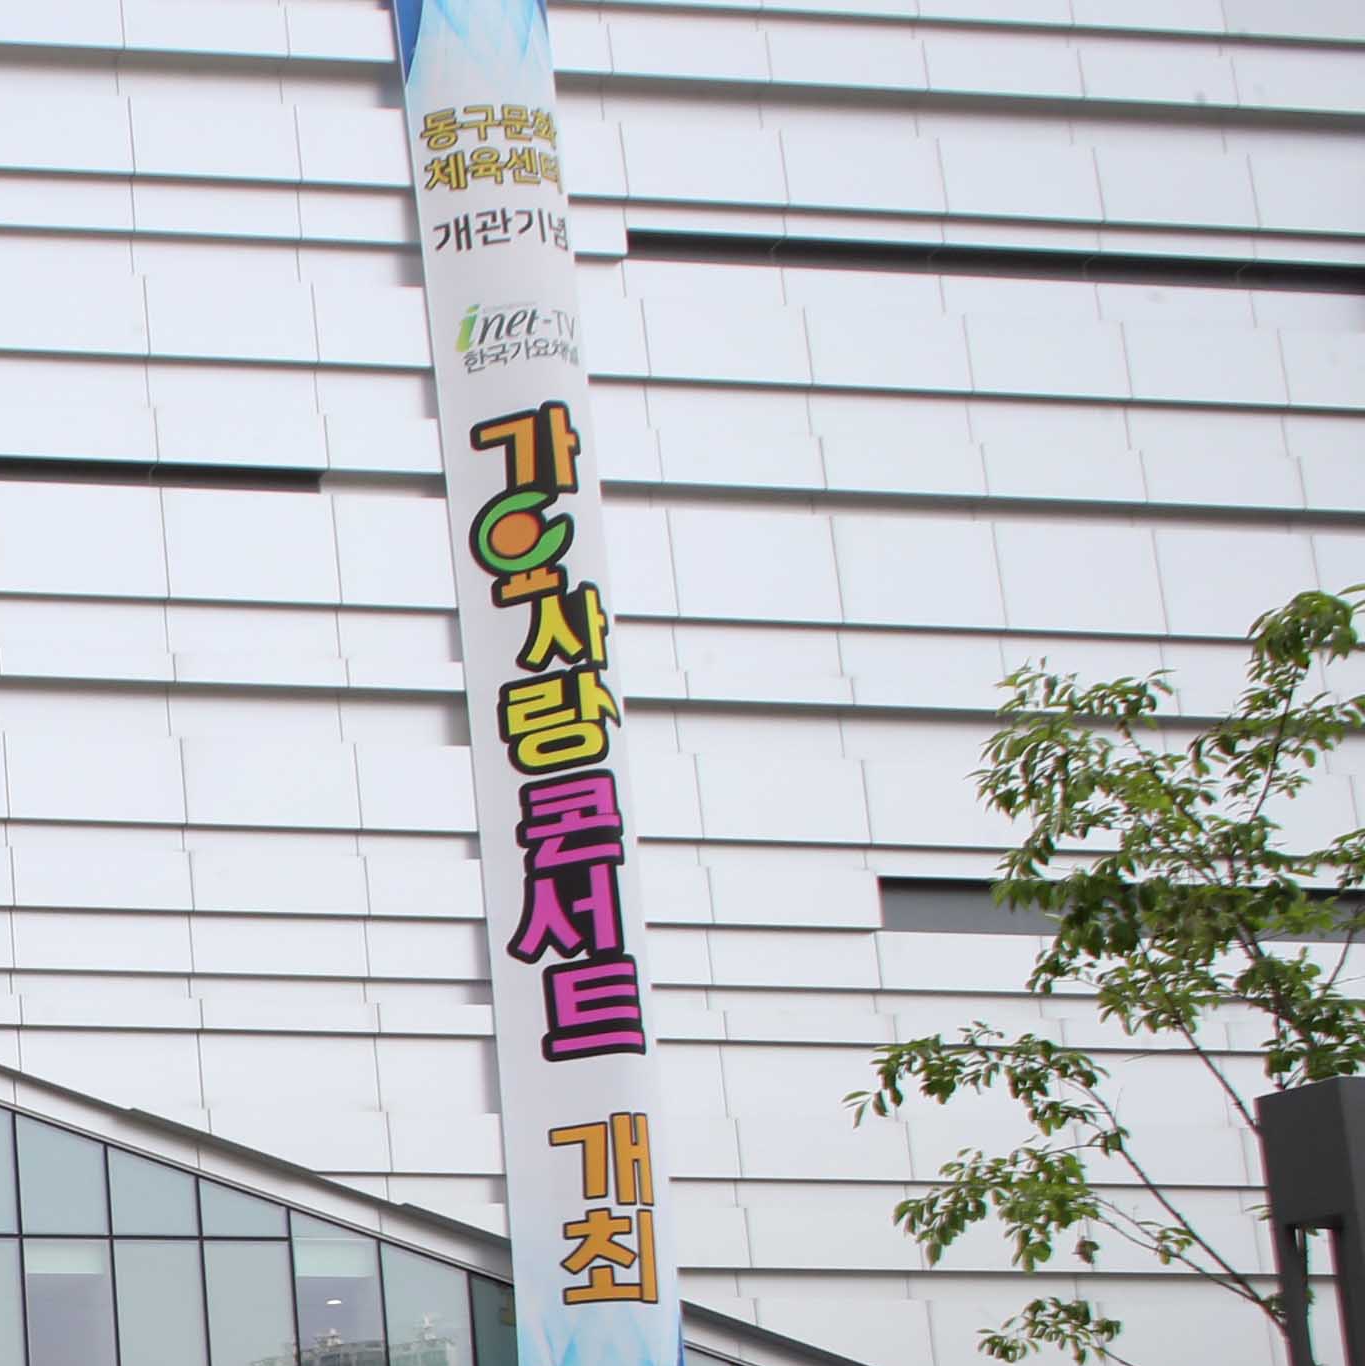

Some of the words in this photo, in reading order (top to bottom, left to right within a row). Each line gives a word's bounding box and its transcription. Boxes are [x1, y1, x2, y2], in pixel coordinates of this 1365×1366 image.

[420, 103, 558, 150] 동구문화
[424, 146, 563, 194] 체육센터
[432, 206, 569, 252] 개관기념
[548, 1111, 659, 1305] 개최
